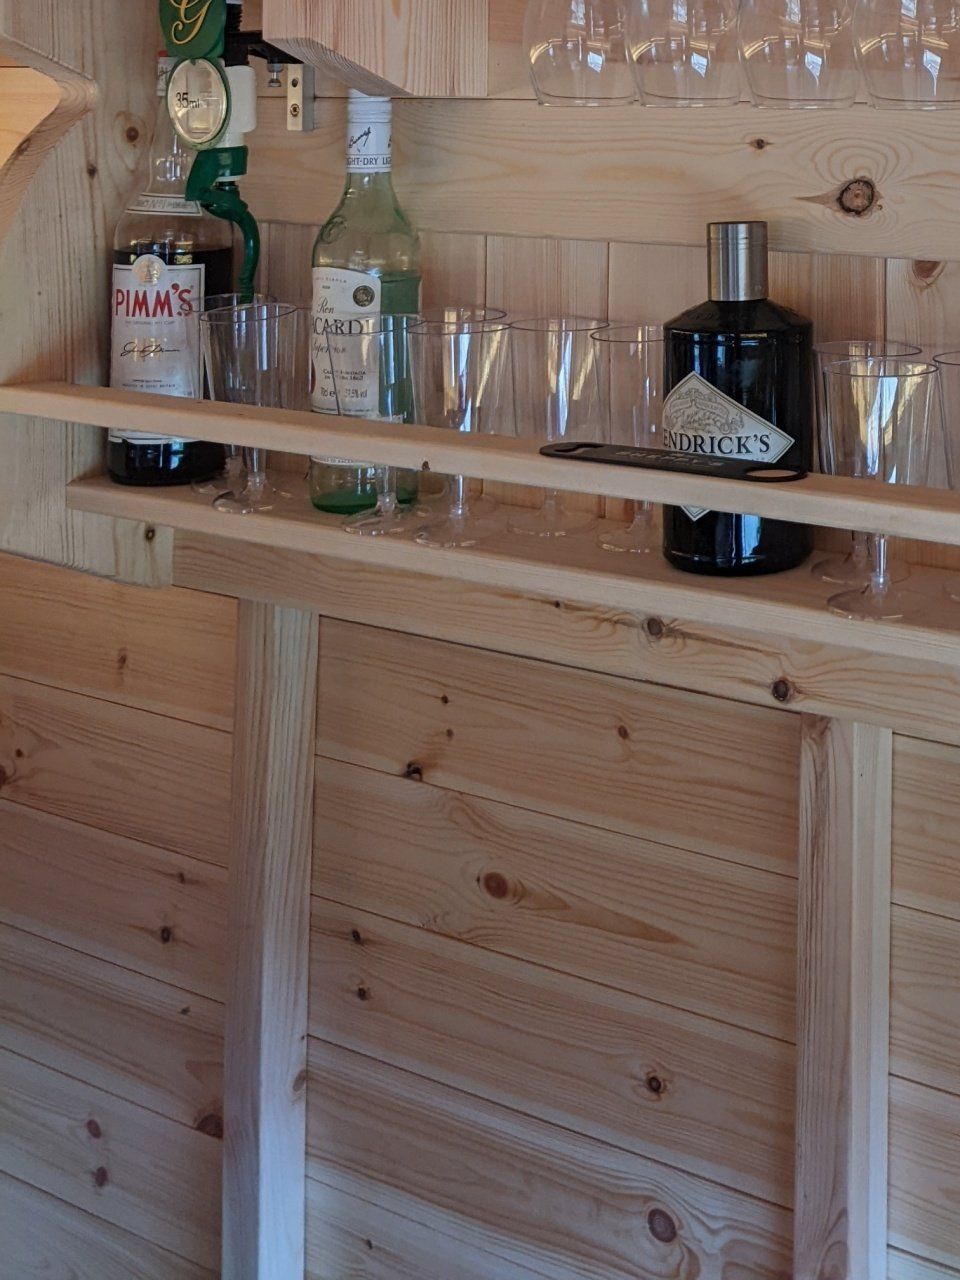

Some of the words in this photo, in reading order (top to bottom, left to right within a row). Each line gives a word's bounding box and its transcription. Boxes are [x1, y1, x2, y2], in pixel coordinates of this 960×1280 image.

[176, 92, 188, 108] 35
[347, 157, 378, 166] GHT-DRY
[116, 283, 193, 318] PIMM'S
[663, 429, 770, 455] ENDRICK'S
